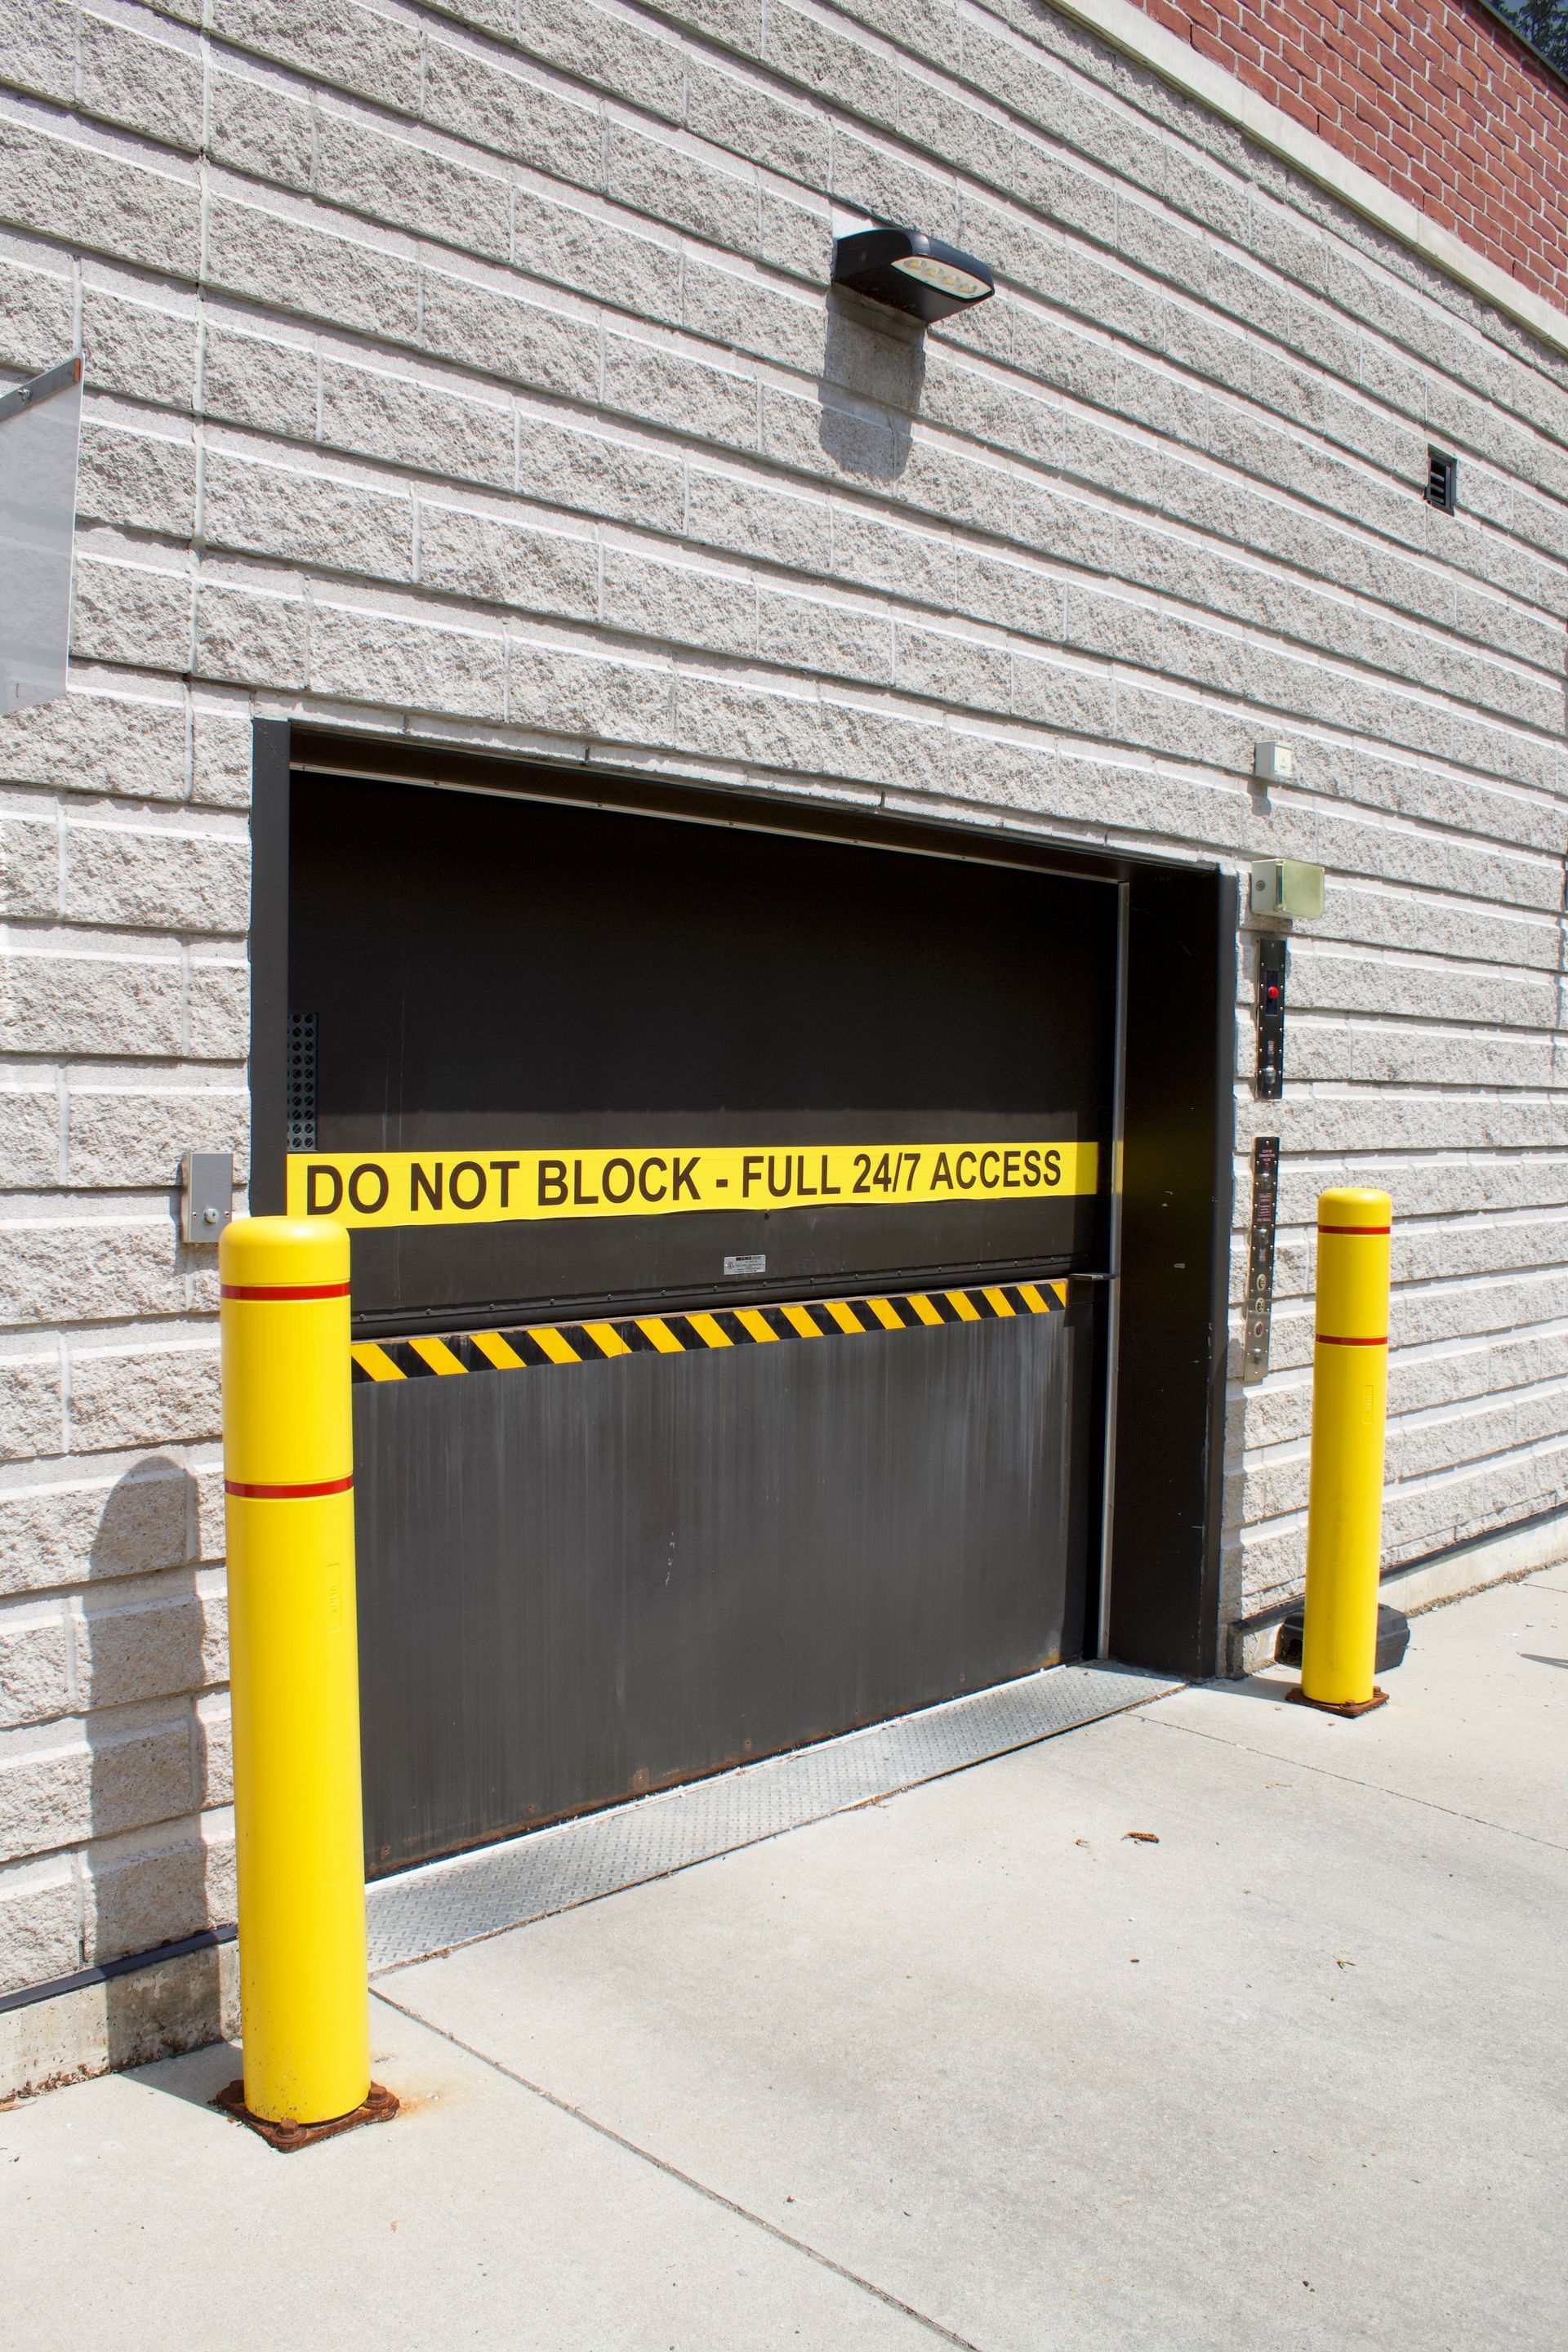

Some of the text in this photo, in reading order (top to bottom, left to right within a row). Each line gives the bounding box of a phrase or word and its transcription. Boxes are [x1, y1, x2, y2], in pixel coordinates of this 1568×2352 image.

[306, 1149, 1062, 1216] DO NOT BLOCK - FULL 24/7 ACCESS
